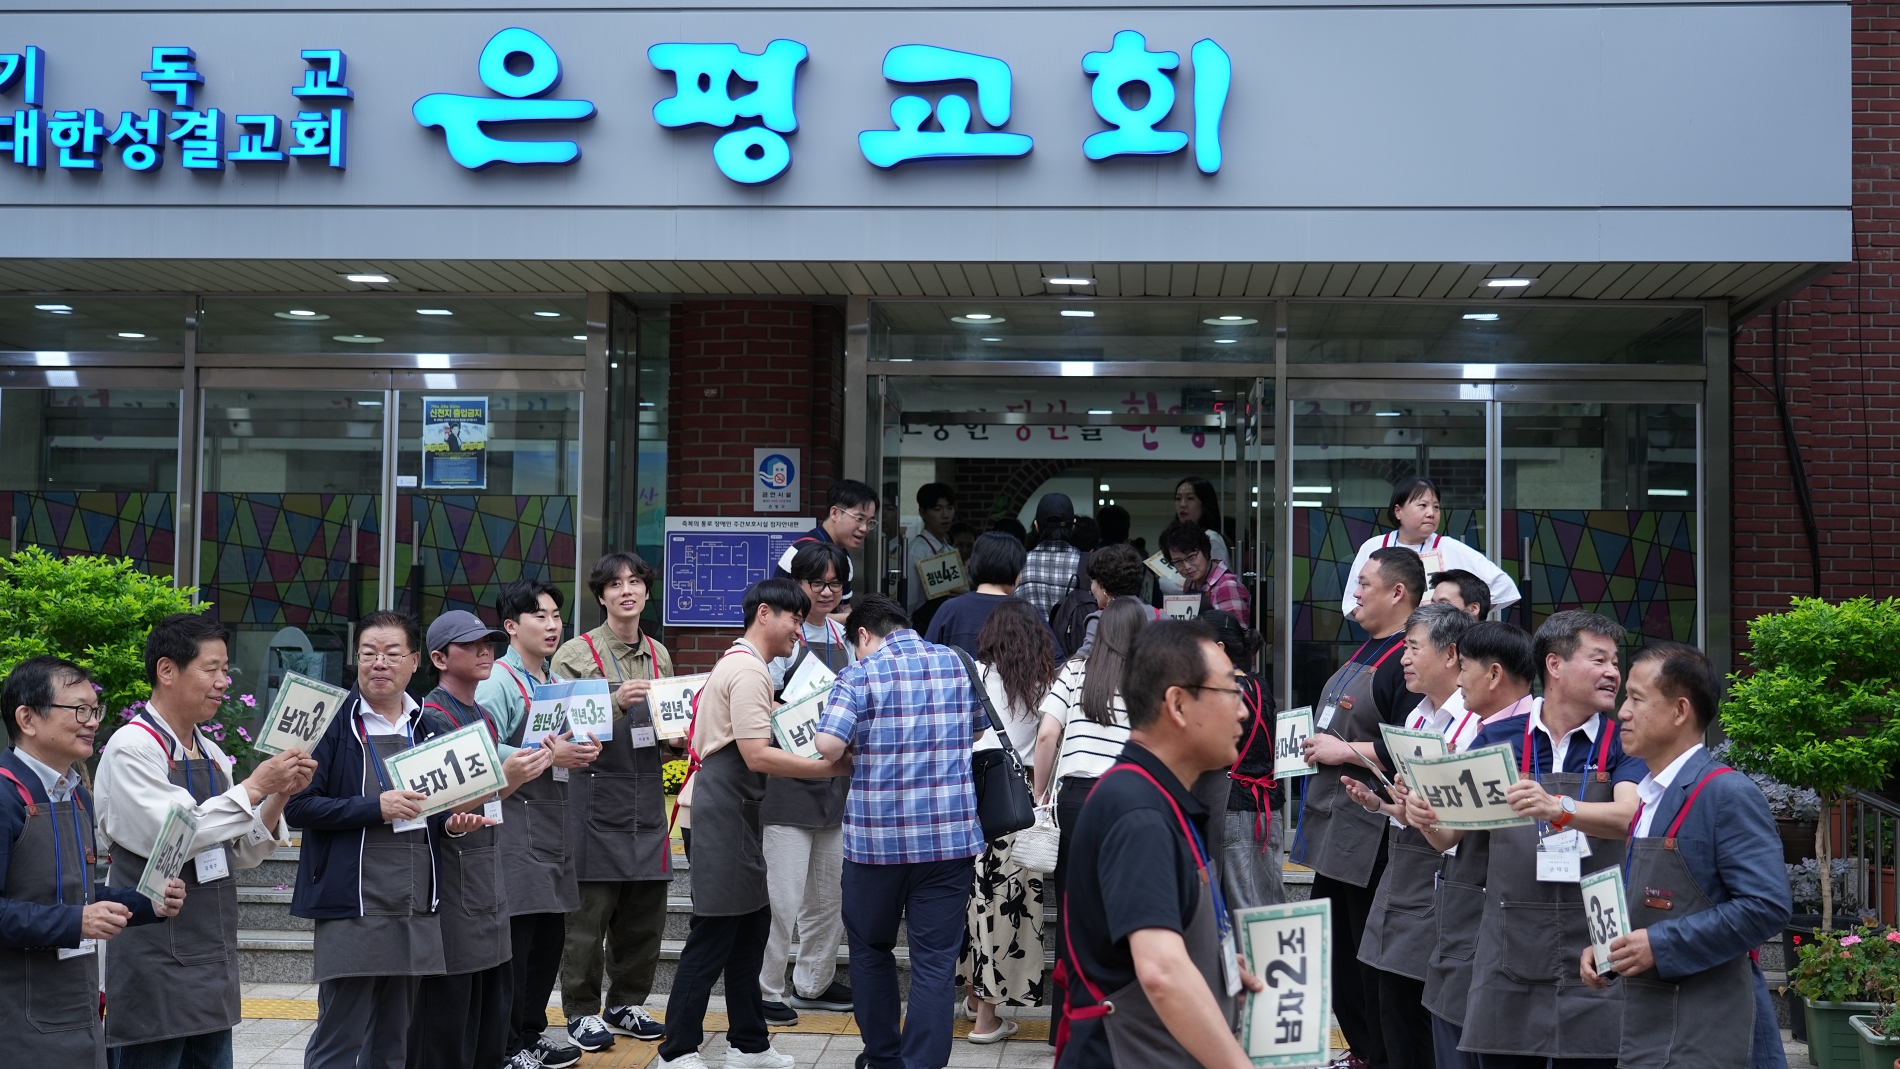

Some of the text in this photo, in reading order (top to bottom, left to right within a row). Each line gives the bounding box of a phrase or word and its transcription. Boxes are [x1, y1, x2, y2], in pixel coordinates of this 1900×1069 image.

[411, 26, 1232, 185] 은평교회
[0, 107, 348, 172] 대한성결교회
[430, 409, 452, 418] 신천지
[639, 486, 659, 507] 산
[926, 561, 960, 586] 청년4조
[570, 698, 607, 726] 청년3조
[788, 701, 825, 748] 남자
[408, 748, 488, 797] 남자1조
[1422, 768, 1508, 809] 남자1조
[1264, 926, 1308, 1045] 남자2조
